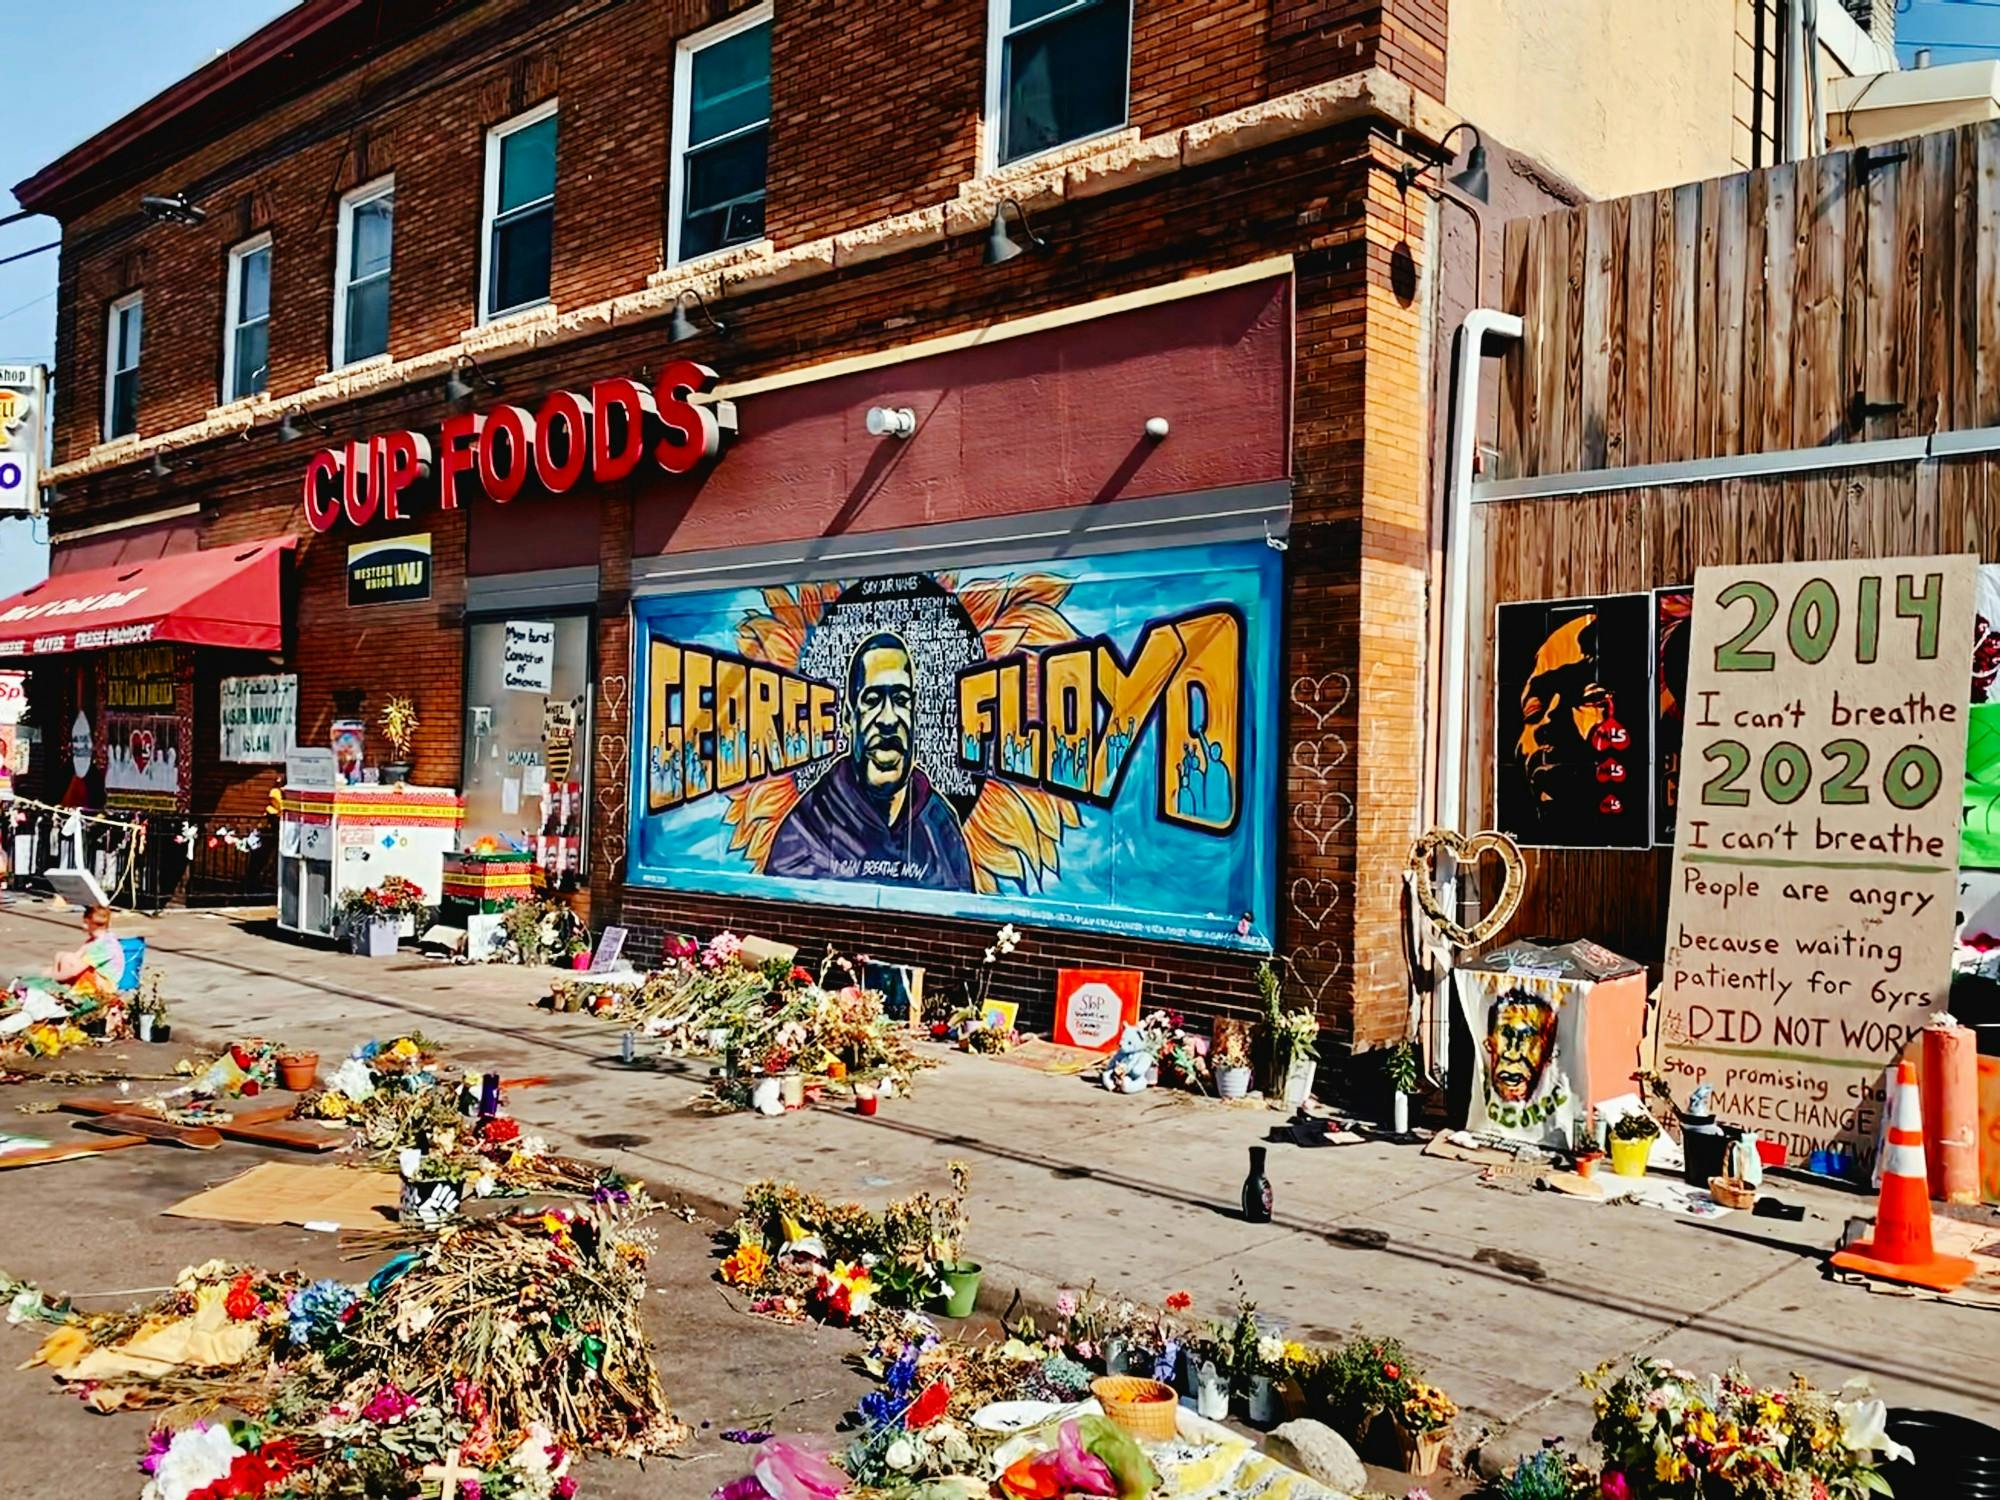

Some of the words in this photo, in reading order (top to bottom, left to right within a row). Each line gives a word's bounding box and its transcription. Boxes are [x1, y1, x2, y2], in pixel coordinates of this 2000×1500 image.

[303, 430, 427, 533] CUP
[440, 360, 713, 510] FOODS
[353, 564, 393, 580] WESTERN
[365, 576, 393, 590] UNION
[397, 560, 424, 587] WU
[861, 581, 878, 595] SAY
[878, 580, 896, 593] OUR
[1714, 573, 1943, 672] 2014
[649, 636, 836, 812] GEORGE
[959, 606, 1244, 834] FLOYD
[1696, 691, 1720, 726] I
[1734, 699, 1806, 728] can't
[1831, 690, 1957, 726] breathe
[1701, 739, 1943, 810] 2020
[1687, 820, 1710, 849] I
[1722, 820, 1798, 850] can't
[1816, 818, 1944, 857] breathe
[860, 860, 901, 877] BREATHE
[901, 862, 929, 881] NOW
[1684, 867, 1759, 909] People
[1783, 883, 1829, 902] are
[1850, 888, 1935, 917] angry
[1679, 923, 1779, 954] because
[1796, 930, 1902, 973] waiting
[1673, 963, 1792, 1006] patiently
[1808, 970, 1852, 995] for
[1871, 979, 1932, 1012] 6yrs
[1688, 1005, 1762, 1043] DID
[1773, 1015, 1830, 1047] NOT
[1663, 1055, 1707, 1085] Stop
[1725, 1067, 1829, 1102] promising
